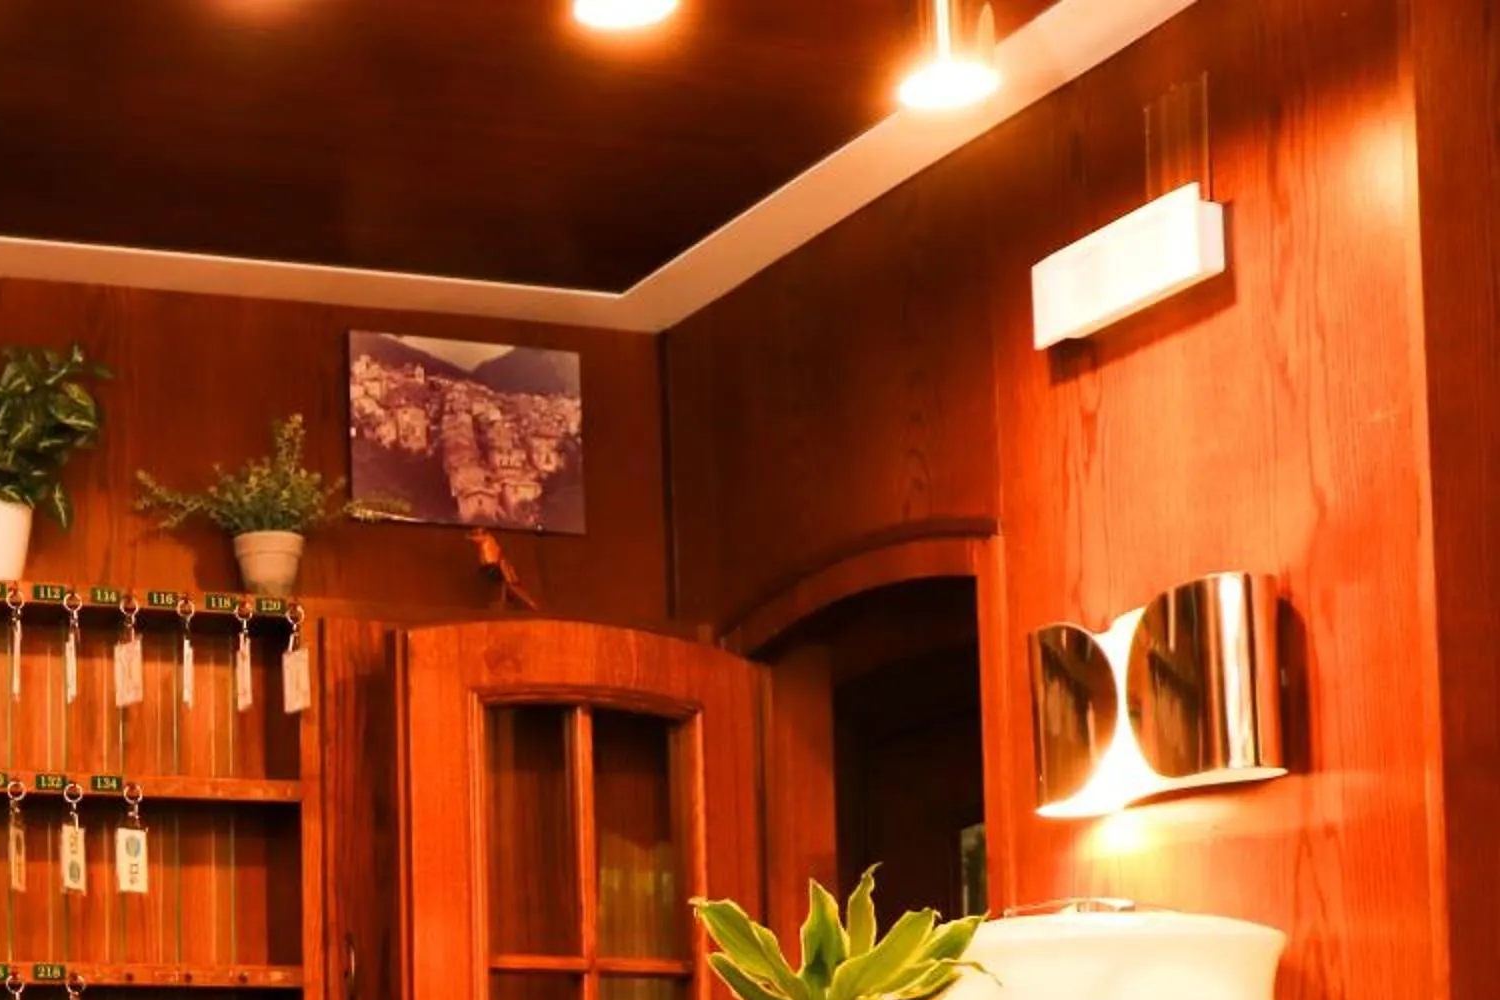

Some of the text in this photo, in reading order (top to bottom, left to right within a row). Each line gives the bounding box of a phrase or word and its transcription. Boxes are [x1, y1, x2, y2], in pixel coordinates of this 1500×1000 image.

[39, 586, 61, 599] 112
[96, 589, 117, 602] 114
[152, 593, 174, 605] 116
[211, 597, 231, 609] 118
[260, 600, 281, 612] 120
[40, 776, 63, 788] 132
[96, 778, 117, 790] 134
[37, 965, 61, 978] 218
